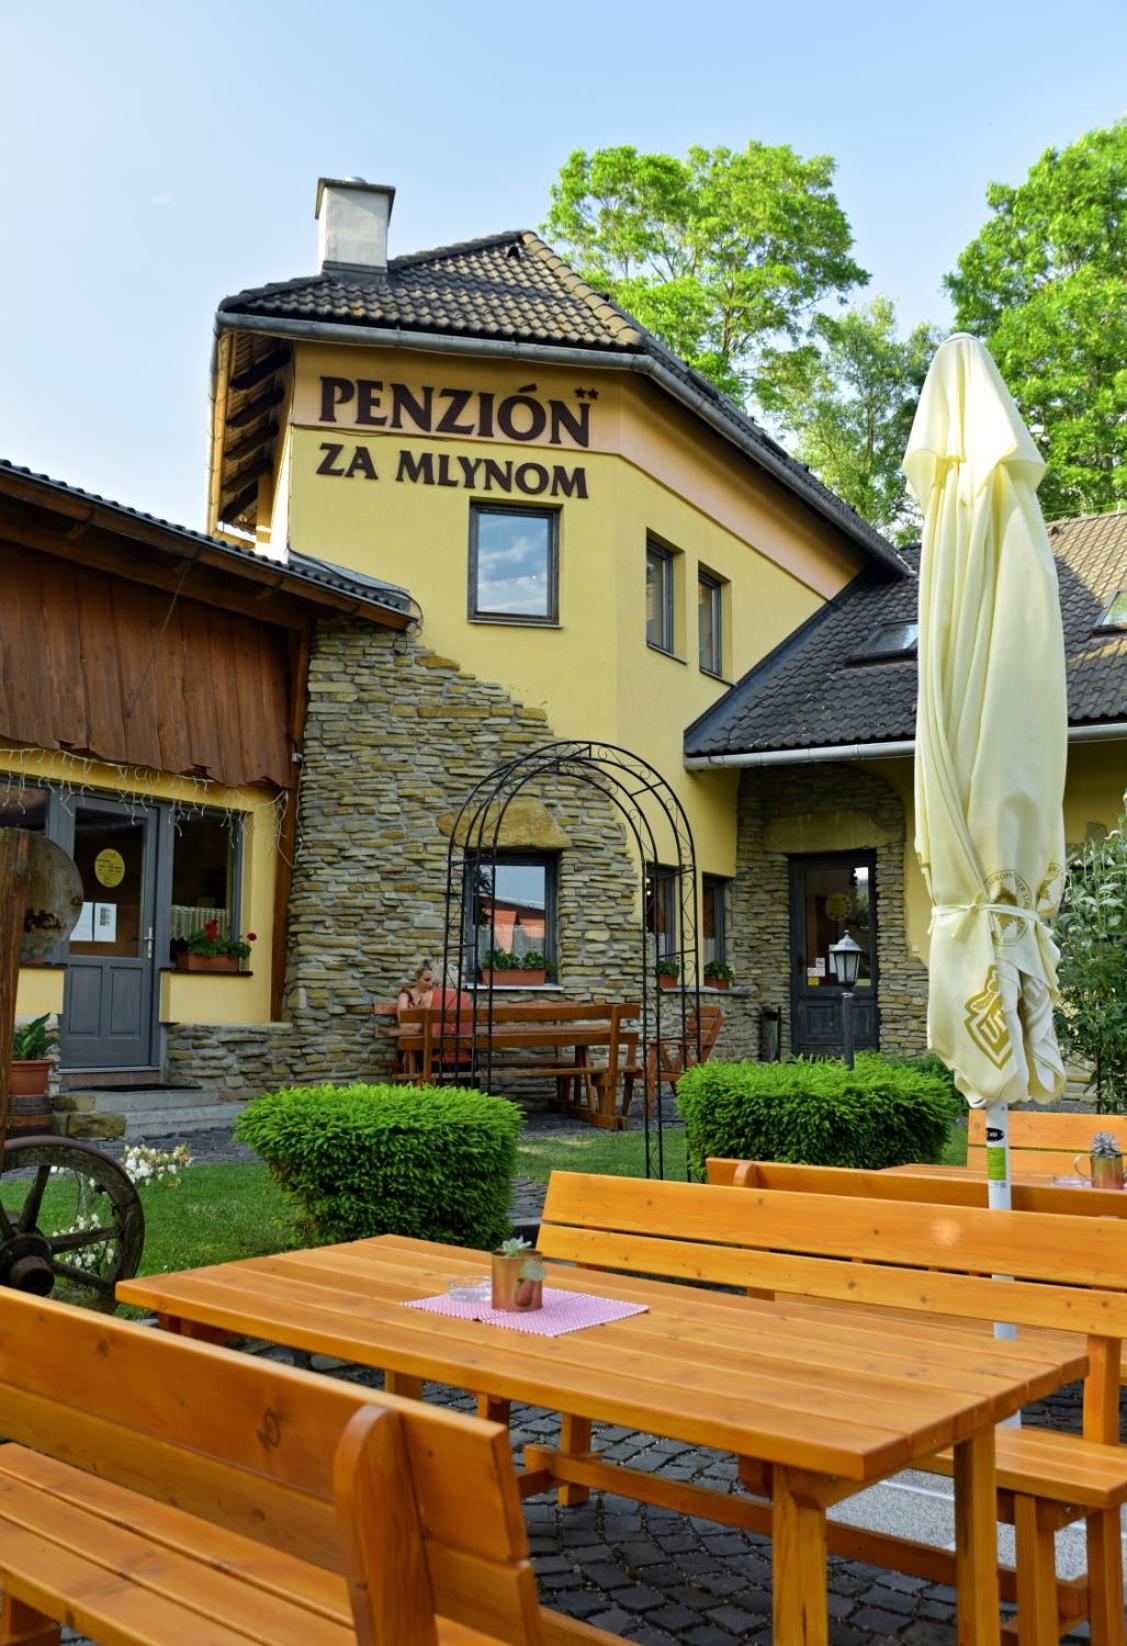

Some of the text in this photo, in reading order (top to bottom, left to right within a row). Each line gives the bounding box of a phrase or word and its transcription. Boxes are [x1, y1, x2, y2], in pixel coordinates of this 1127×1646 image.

[318, 375, 591, 448] PENZIÓN
[316, 442, 589, 499] ZA MLYNOM
